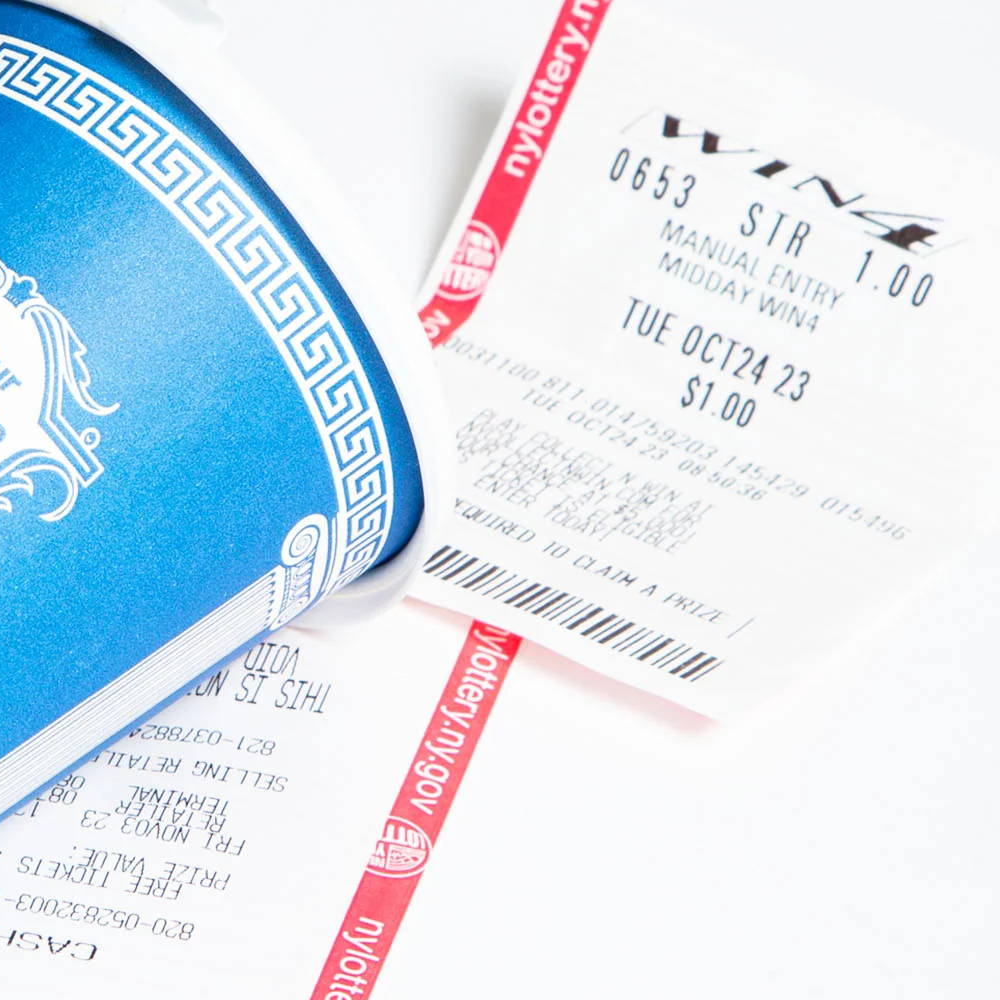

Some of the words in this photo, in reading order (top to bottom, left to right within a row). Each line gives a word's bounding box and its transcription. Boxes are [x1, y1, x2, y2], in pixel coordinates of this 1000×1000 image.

[608, 147, 698, 209] 0653
[740, 203, 813, 259] STR
[855, 250, 935, 308] 1.00
[659, 219, 761, 281] MANUAL
[767, 265, 845, 312] ENTRY
[658, 250, 754, 316] MIDDAY
[760, 293, 820, 335] WIN4
[621, 295, 680, 358] TUE
[681, 323, 770, 386] OCT24
[774, 369, 812, 404] 23
[680, 374, 758, 429] $1.00
[542, 540, 570, 560] TO
[573, 554, 639, 588] CLAIM
[640, 583, 658, 598] A
[663, 592, 730, 626] PRIZE
[243, 641, 300, 673] VOID
[234, 673, 269, 705] IS
[274, 677, 332, 714] THIS
[192, 760, 289, 793] SELLING
[114, 799, 228, 833] RETAILER
[128, 784, 230, 816] TERMINAL
[80, 809, 112, 831] 23
[121, 818, 191, 846] NOV03
[72, 845, 146, 875] VALUE:
[205, 833, 246, 857] FRI
[17, 855, 111, 891] TICKETS
[125, 875, 183, 901] FREE
[163, 861, 232, 892] PRIZE
